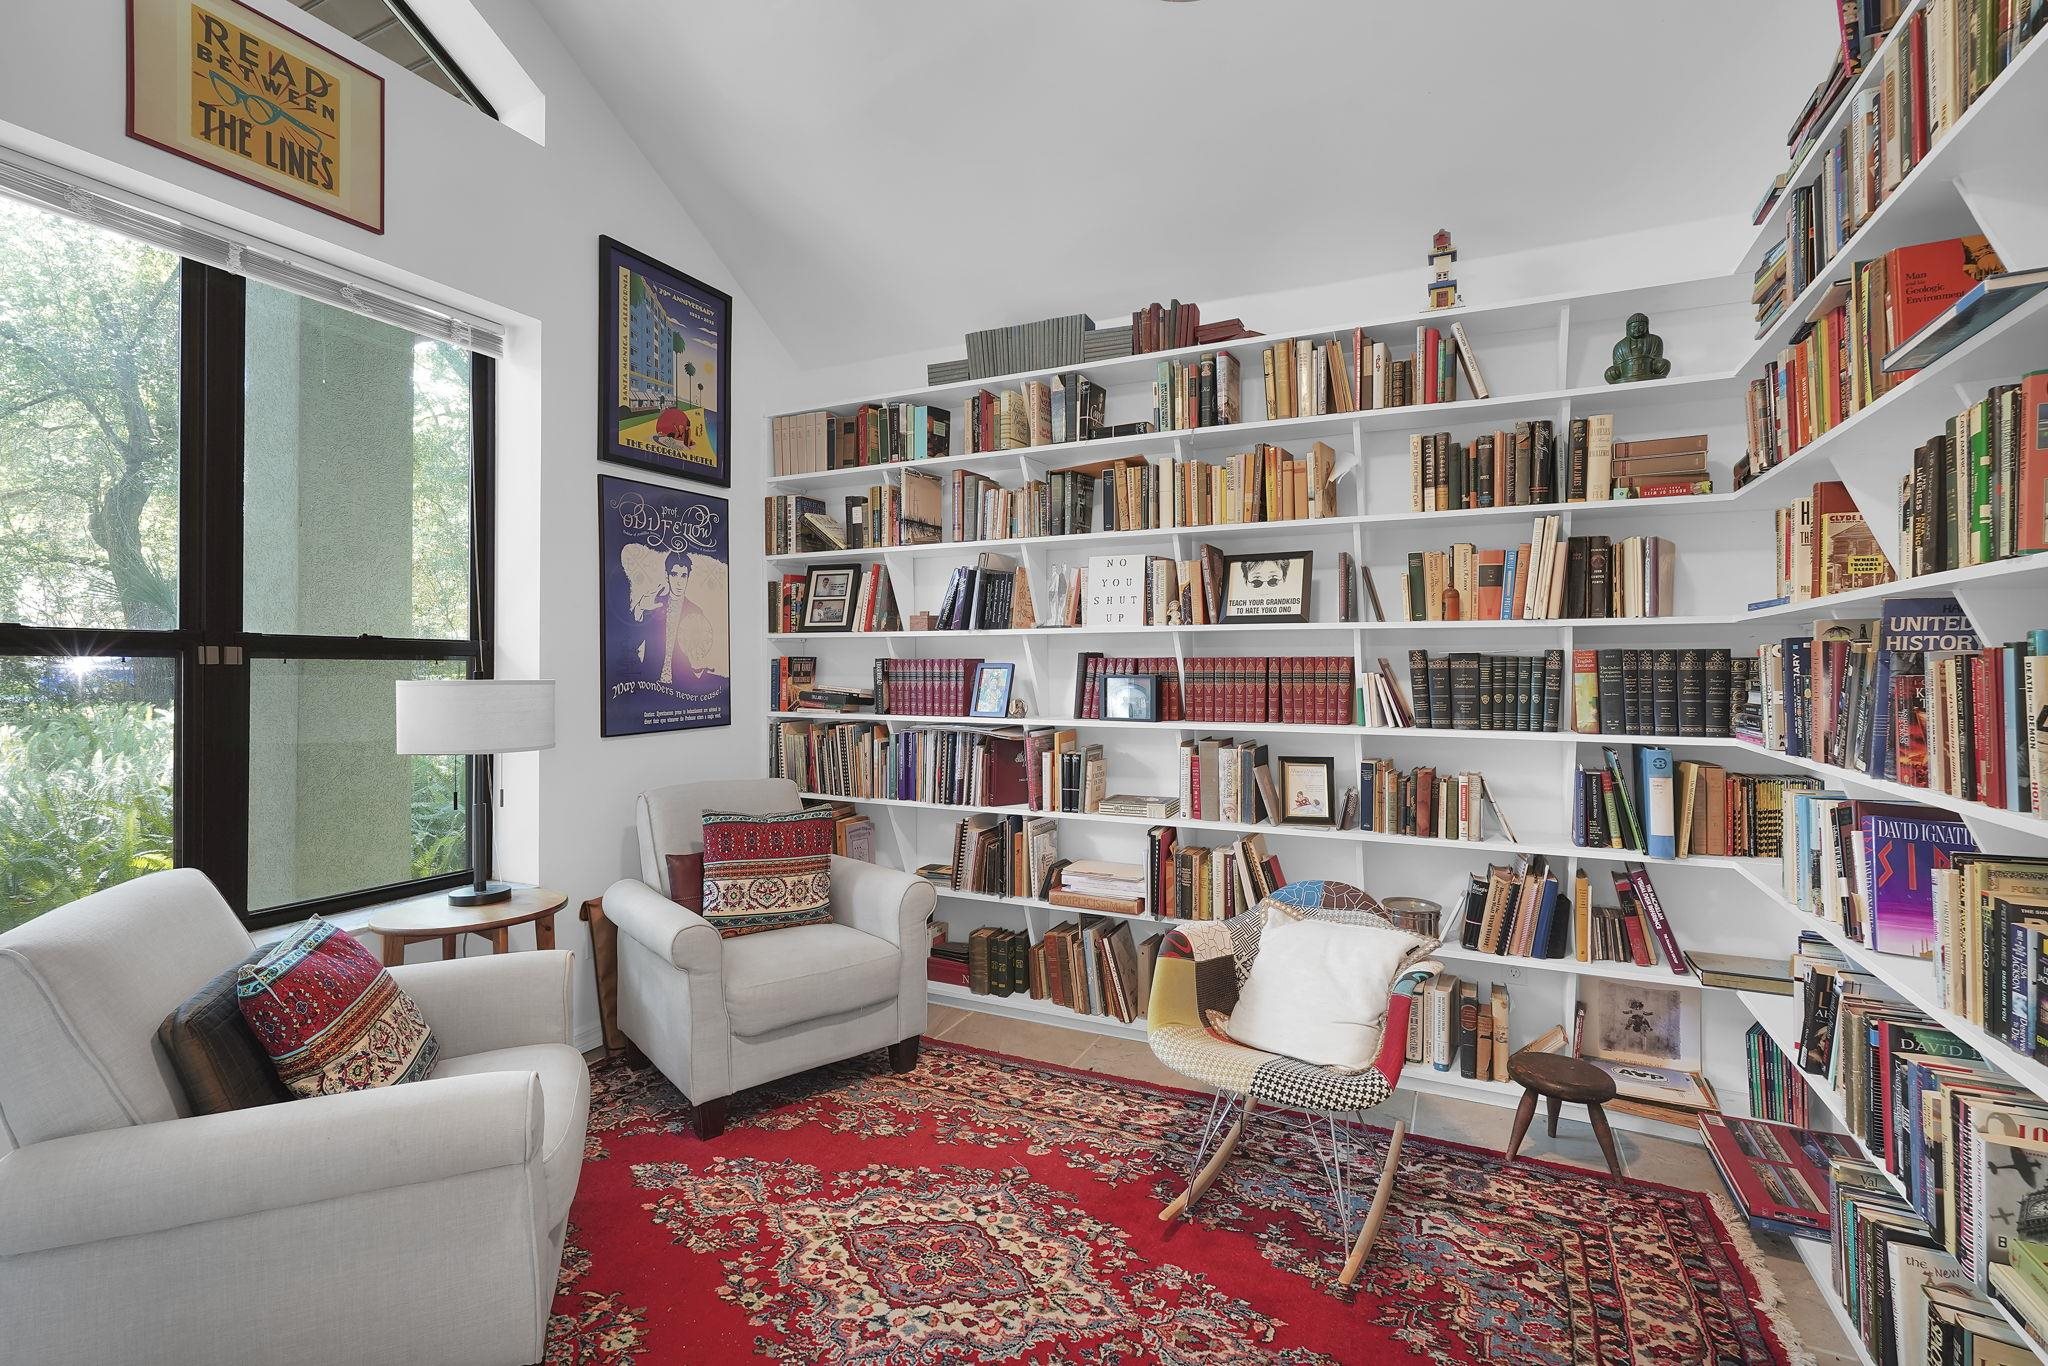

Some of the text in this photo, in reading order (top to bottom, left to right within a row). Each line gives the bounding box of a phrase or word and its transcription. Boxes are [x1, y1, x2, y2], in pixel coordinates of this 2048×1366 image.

[203, 14, 331, 98] READ
[196, 42, 336, 123] BETWEEN
[199, 101, 253, 158] THE
[265, 131, 334, 190] LINES
[1905, 271, 1927, 280] Man
[1905, 284, 1946, 295] Geologic
[1906, 290, 1966, 304] Environment
[672, 294, 715, 317] ANNIVERSARY
[625, 438, 713, 466] THE GEORGIAN HOTEL
[1915, 466, 1923, 511] LIKENESS
[1829, 514, 1858, 523] CLYDE
[1915, 517, 1923, 552] FRENCH
[1106, 558, 1128, 568] NO
[1101, 578, 1133, 587] YOU
[1093, 595, 1138, 605] SHUT
[1228, 597, 1301, 607] TEACH YOUR GRANDKIDS
[1236, 607, 1244, 615] TO
[1260, 606, 1278, 614] YOKO
[1106, 614, 1125, 623] UP
[1890, 615, 1975, 632] UNITED
[1886, 633, 1984, 651] HISTORY
[2025, 662, 2034, 693] DEATH
[612, 680, 722, 702] May wonders never cease!
[1955, 657, 1966, 753] THE HARVEST READER
[1857, 709, 1866, 733] YARD
[2028, 715, 2037, 749] DEMON
[2031, 782, 2040, 813] HOLT
[1877, 819, 1919, 840] DAVID
[1637, 877, 1648, 893] VISUAL
[1645, 904, 1662, 930] REFERENCE
[1649, 892, 1665, 920] MACMILLAN
[2012, 955, 2021, 992] JACKSON
[2011, 1027, 2019, 1041] Die
[1900, 1038, 1964, 1057] DAVID
[1859, 1174, 1879, 1188] Val
[1865, 1252, 1873, 1282] BLACK
[1905, 1256, 1928, 1269] the
[1934, 1264, 1960, 1280] New
